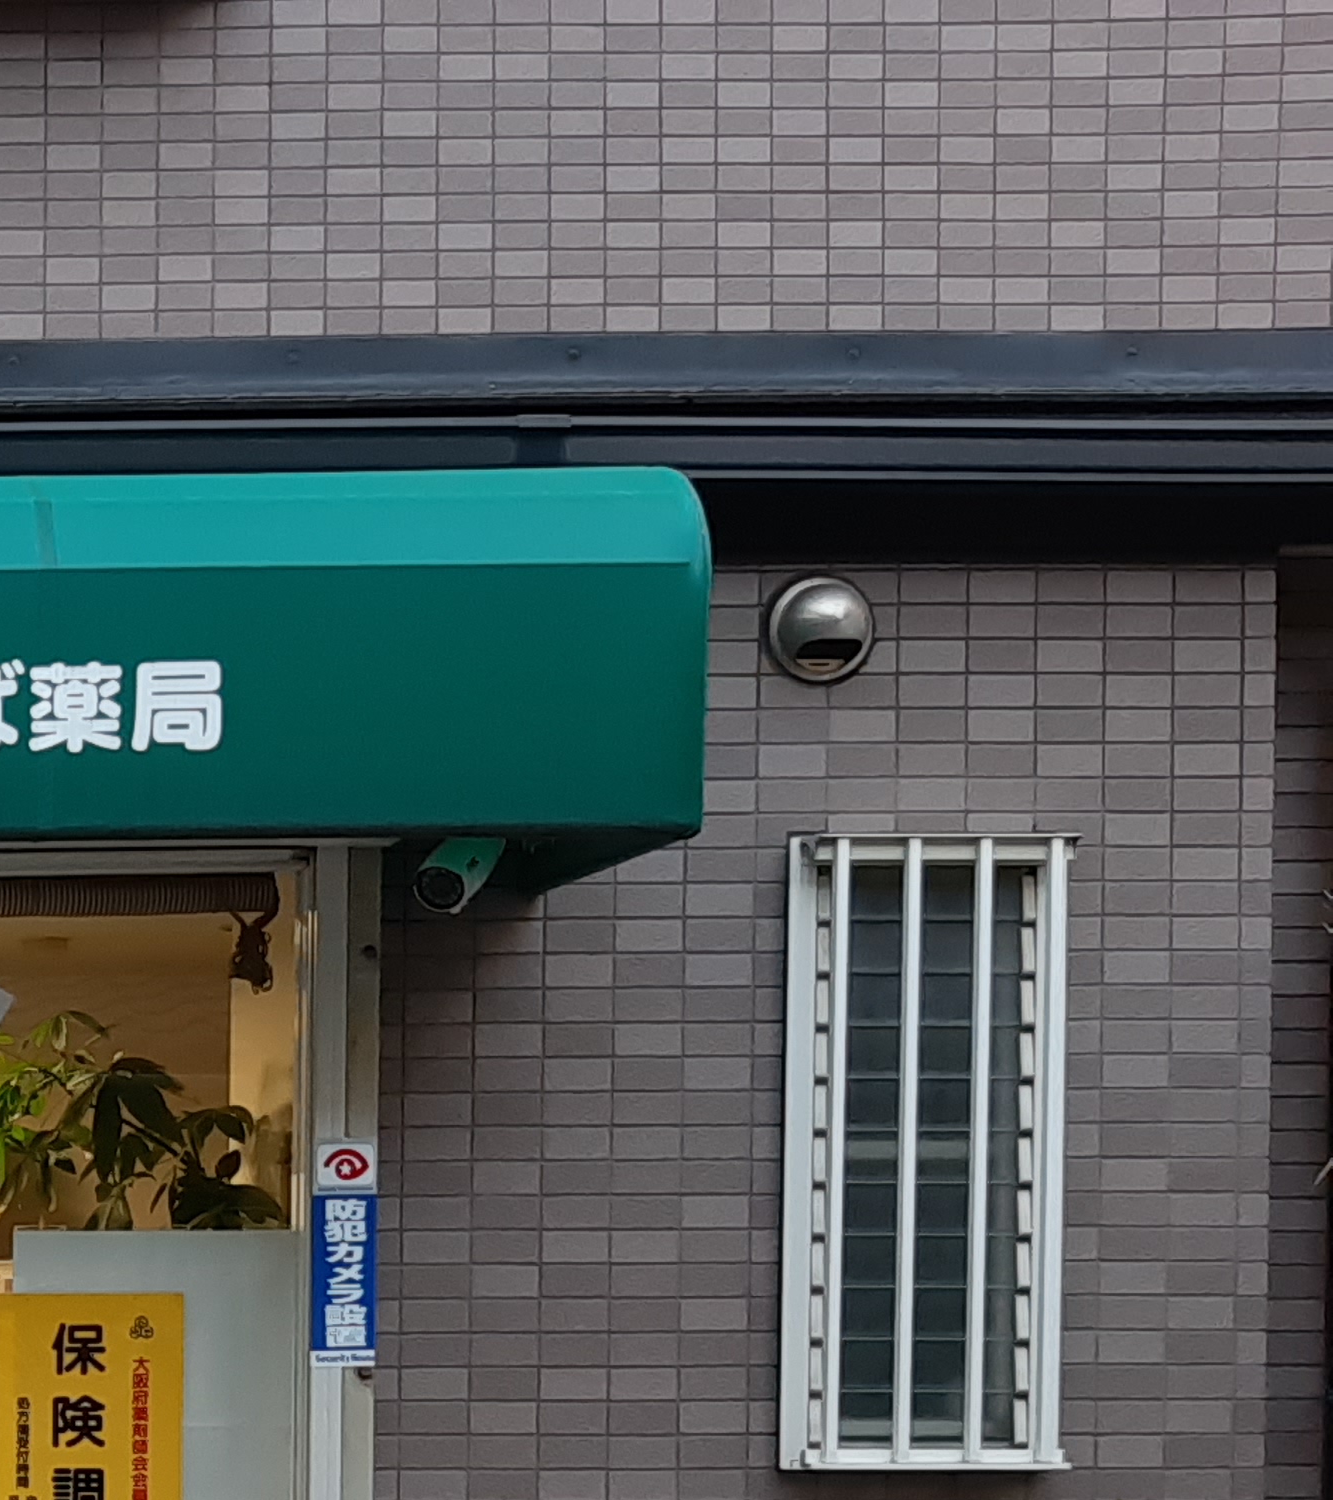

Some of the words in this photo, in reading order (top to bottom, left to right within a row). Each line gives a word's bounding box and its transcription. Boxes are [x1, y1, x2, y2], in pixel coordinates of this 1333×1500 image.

[324, 1199, 367, 1347] 防犯カメラ設置
